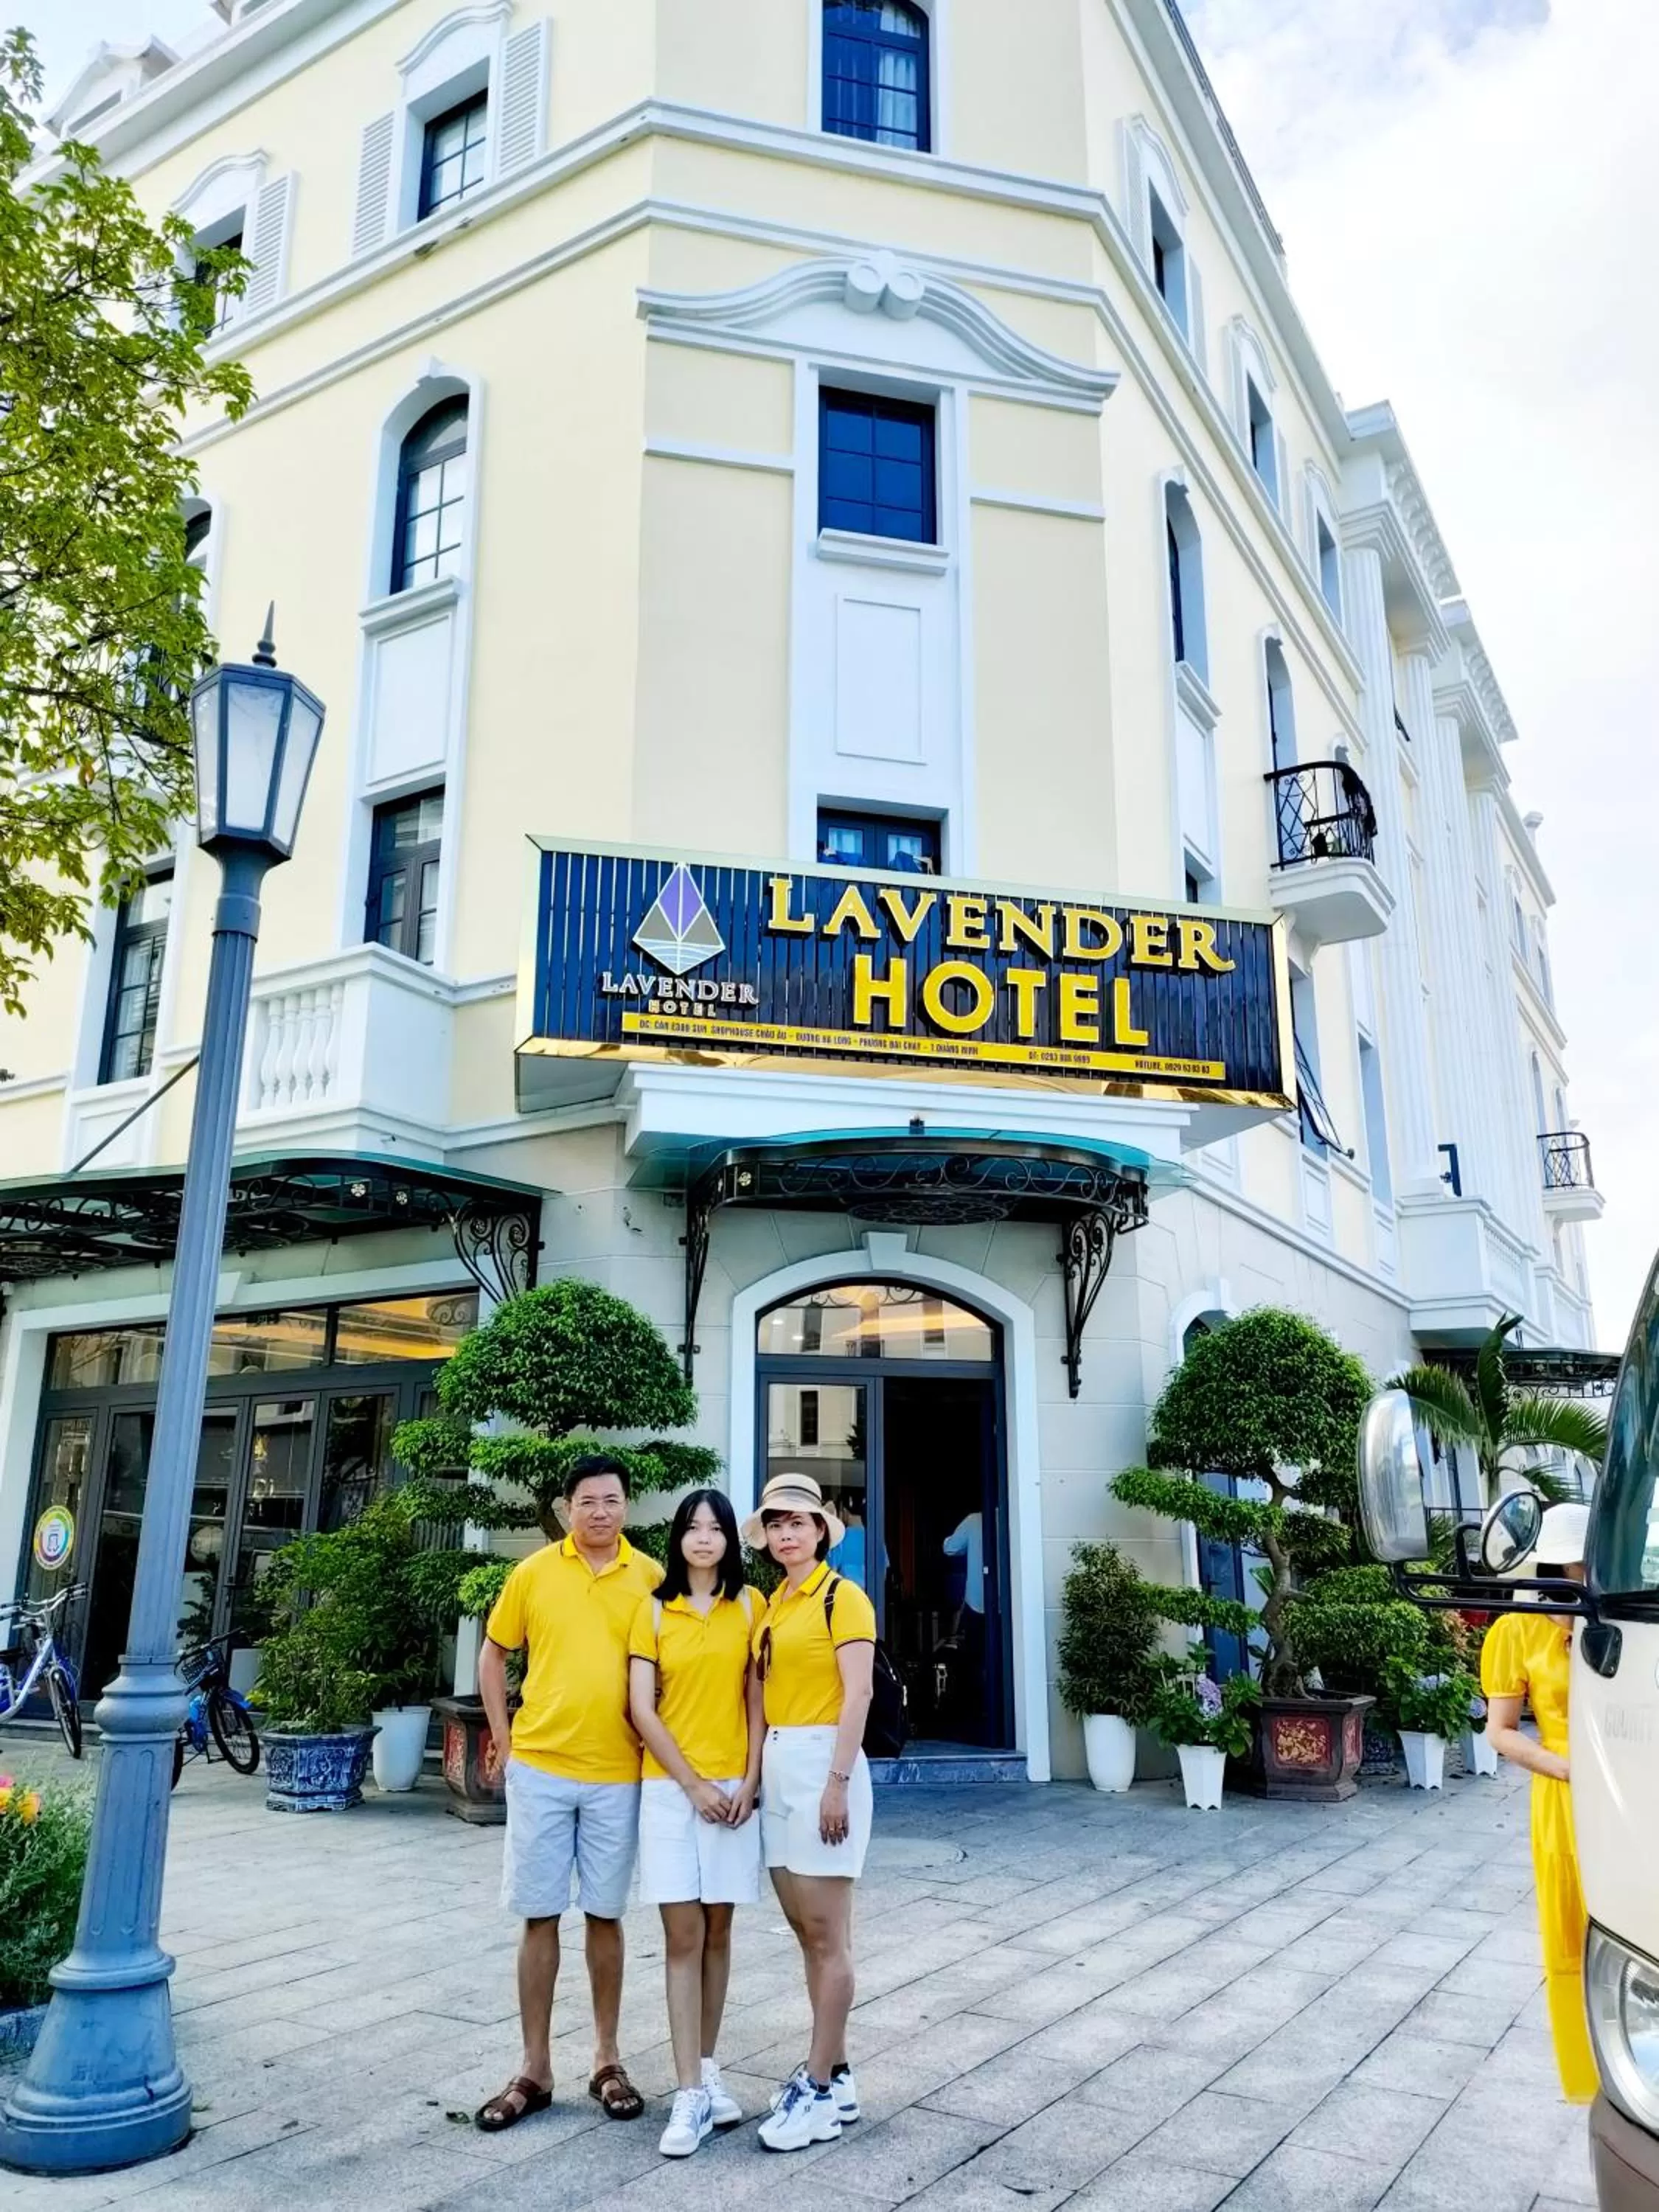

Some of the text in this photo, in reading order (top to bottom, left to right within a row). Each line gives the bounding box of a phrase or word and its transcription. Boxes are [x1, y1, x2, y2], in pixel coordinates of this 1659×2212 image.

[768, 878, 1236, 972] LAVENDER
[602, 971, 759, 1004] LAVENDER
[648, 999, 717, 1018] HOTEL
[853, 953, 1150, 1046] HOTEL
